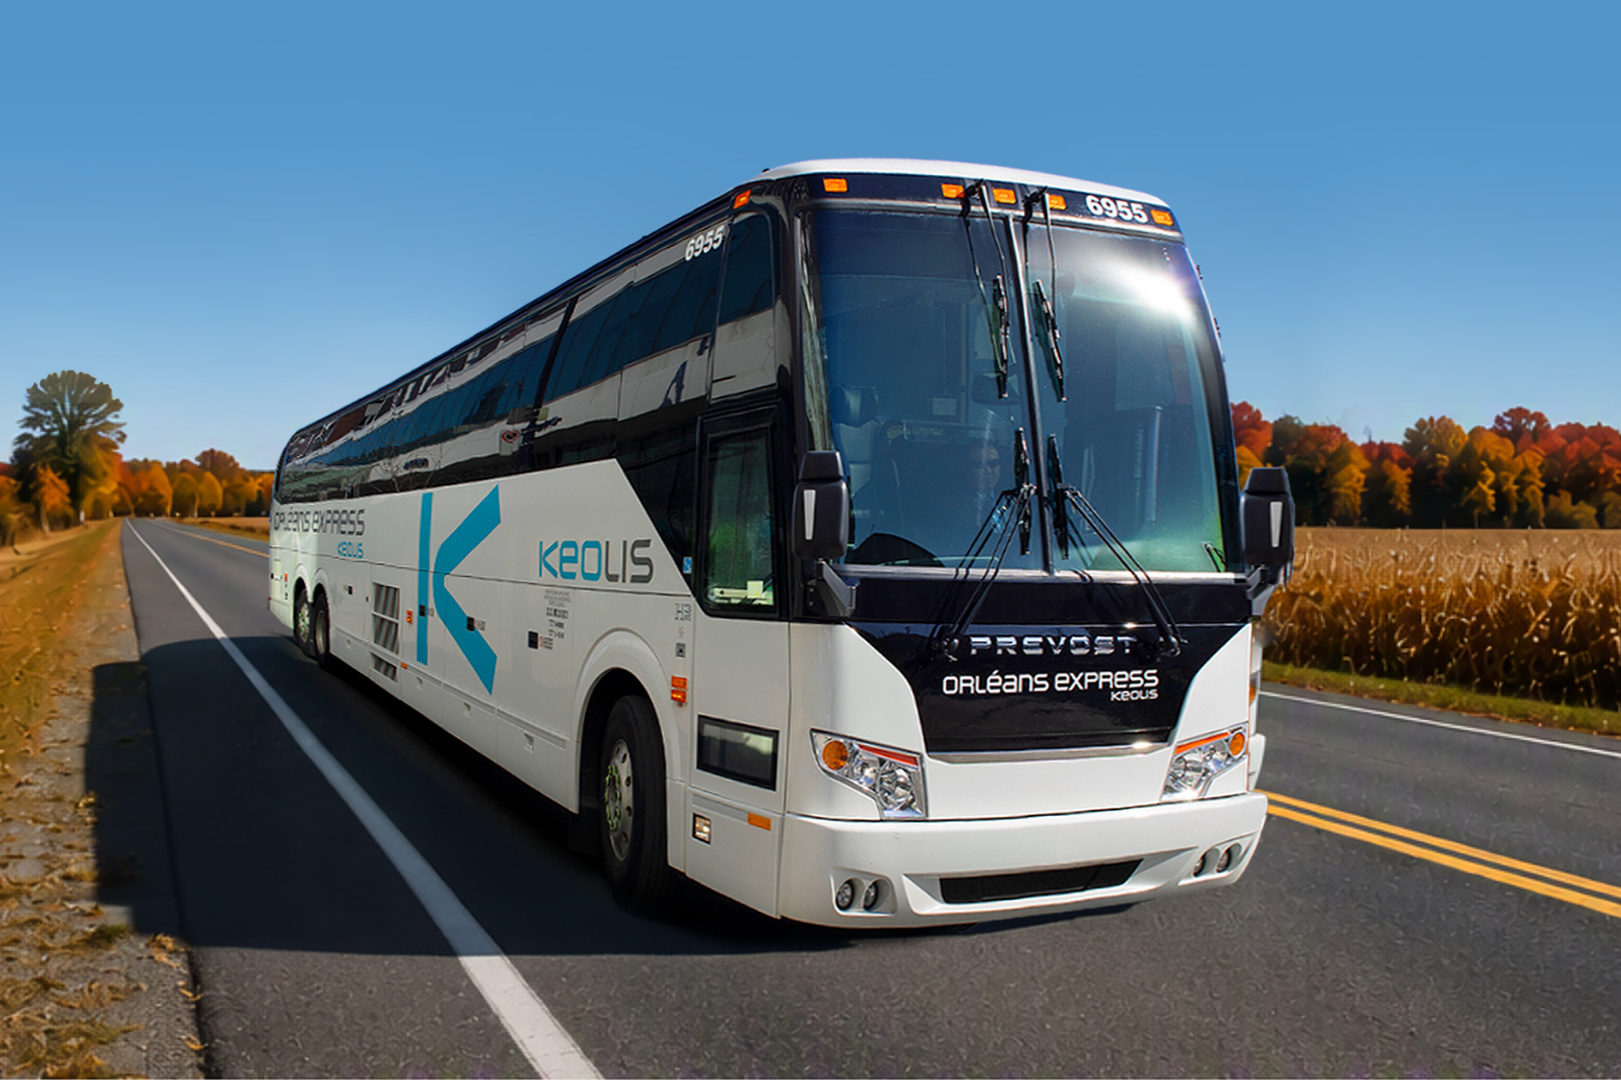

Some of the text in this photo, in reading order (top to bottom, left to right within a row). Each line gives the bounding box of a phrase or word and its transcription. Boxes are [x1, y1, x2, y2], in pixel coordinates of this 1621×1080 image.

[1086, 195, 1148, 224] 6955
[685, 224, 725, 262] 6955
[970, 636, 1137, 655] PREVOST
